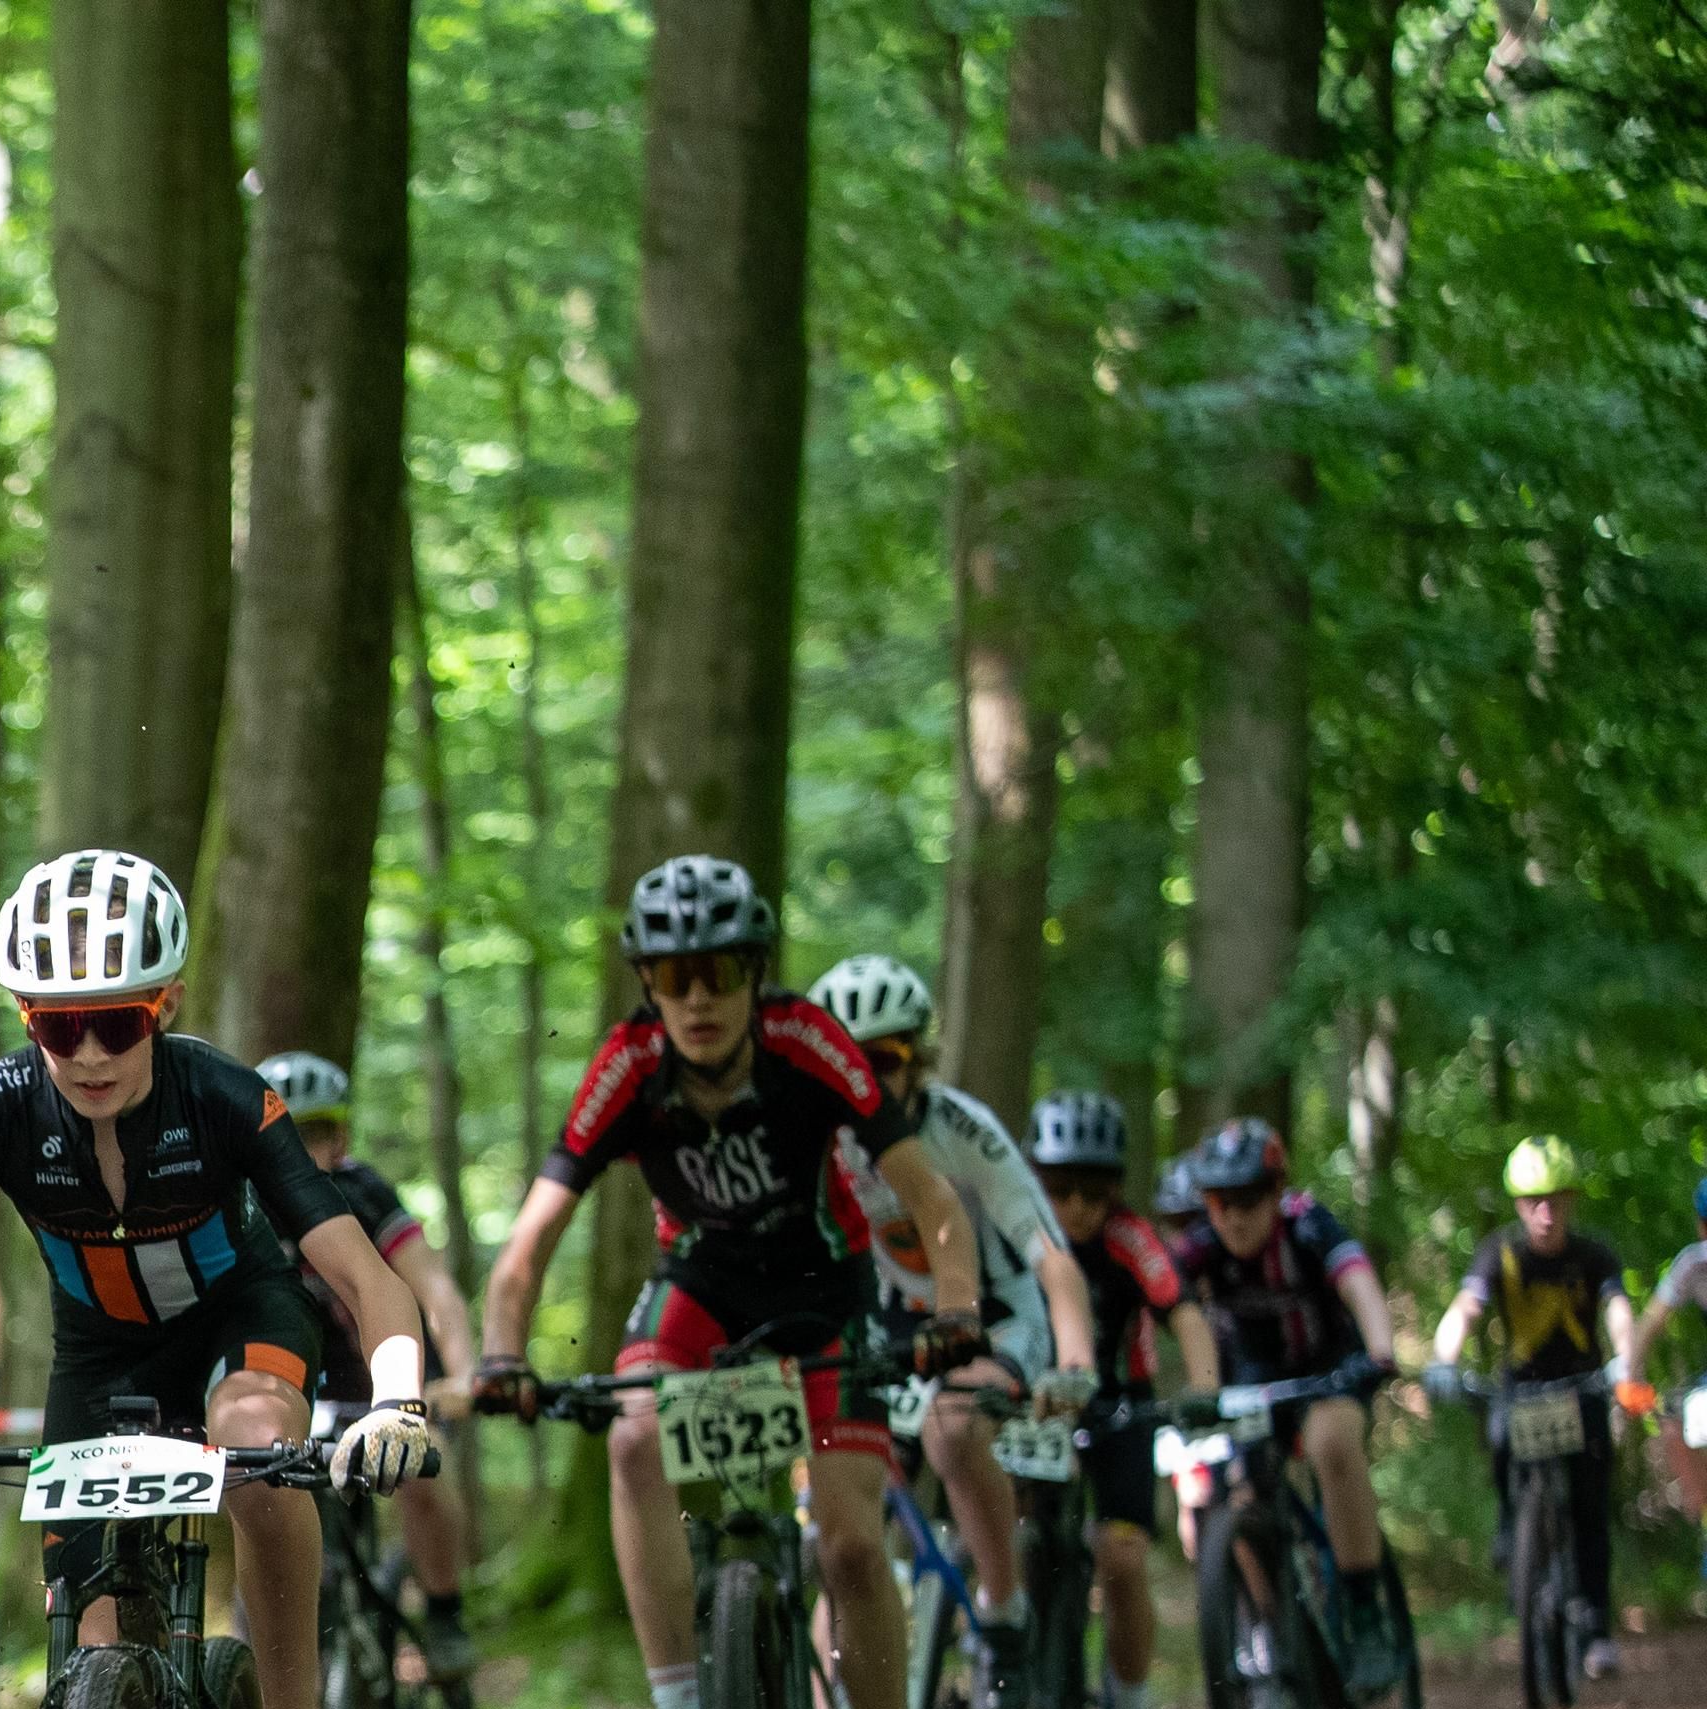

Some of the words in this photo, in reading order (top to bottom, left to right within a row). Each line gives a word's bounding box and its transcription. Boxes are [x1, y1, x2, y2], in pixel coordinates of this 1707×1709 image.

[36, 1171, 80, 1187] Hürter
[666, 1403, 804, 1467] 1523
[70, 1446, 104, 1461] XCO
[36, 1471, 214, 1510] 1552
